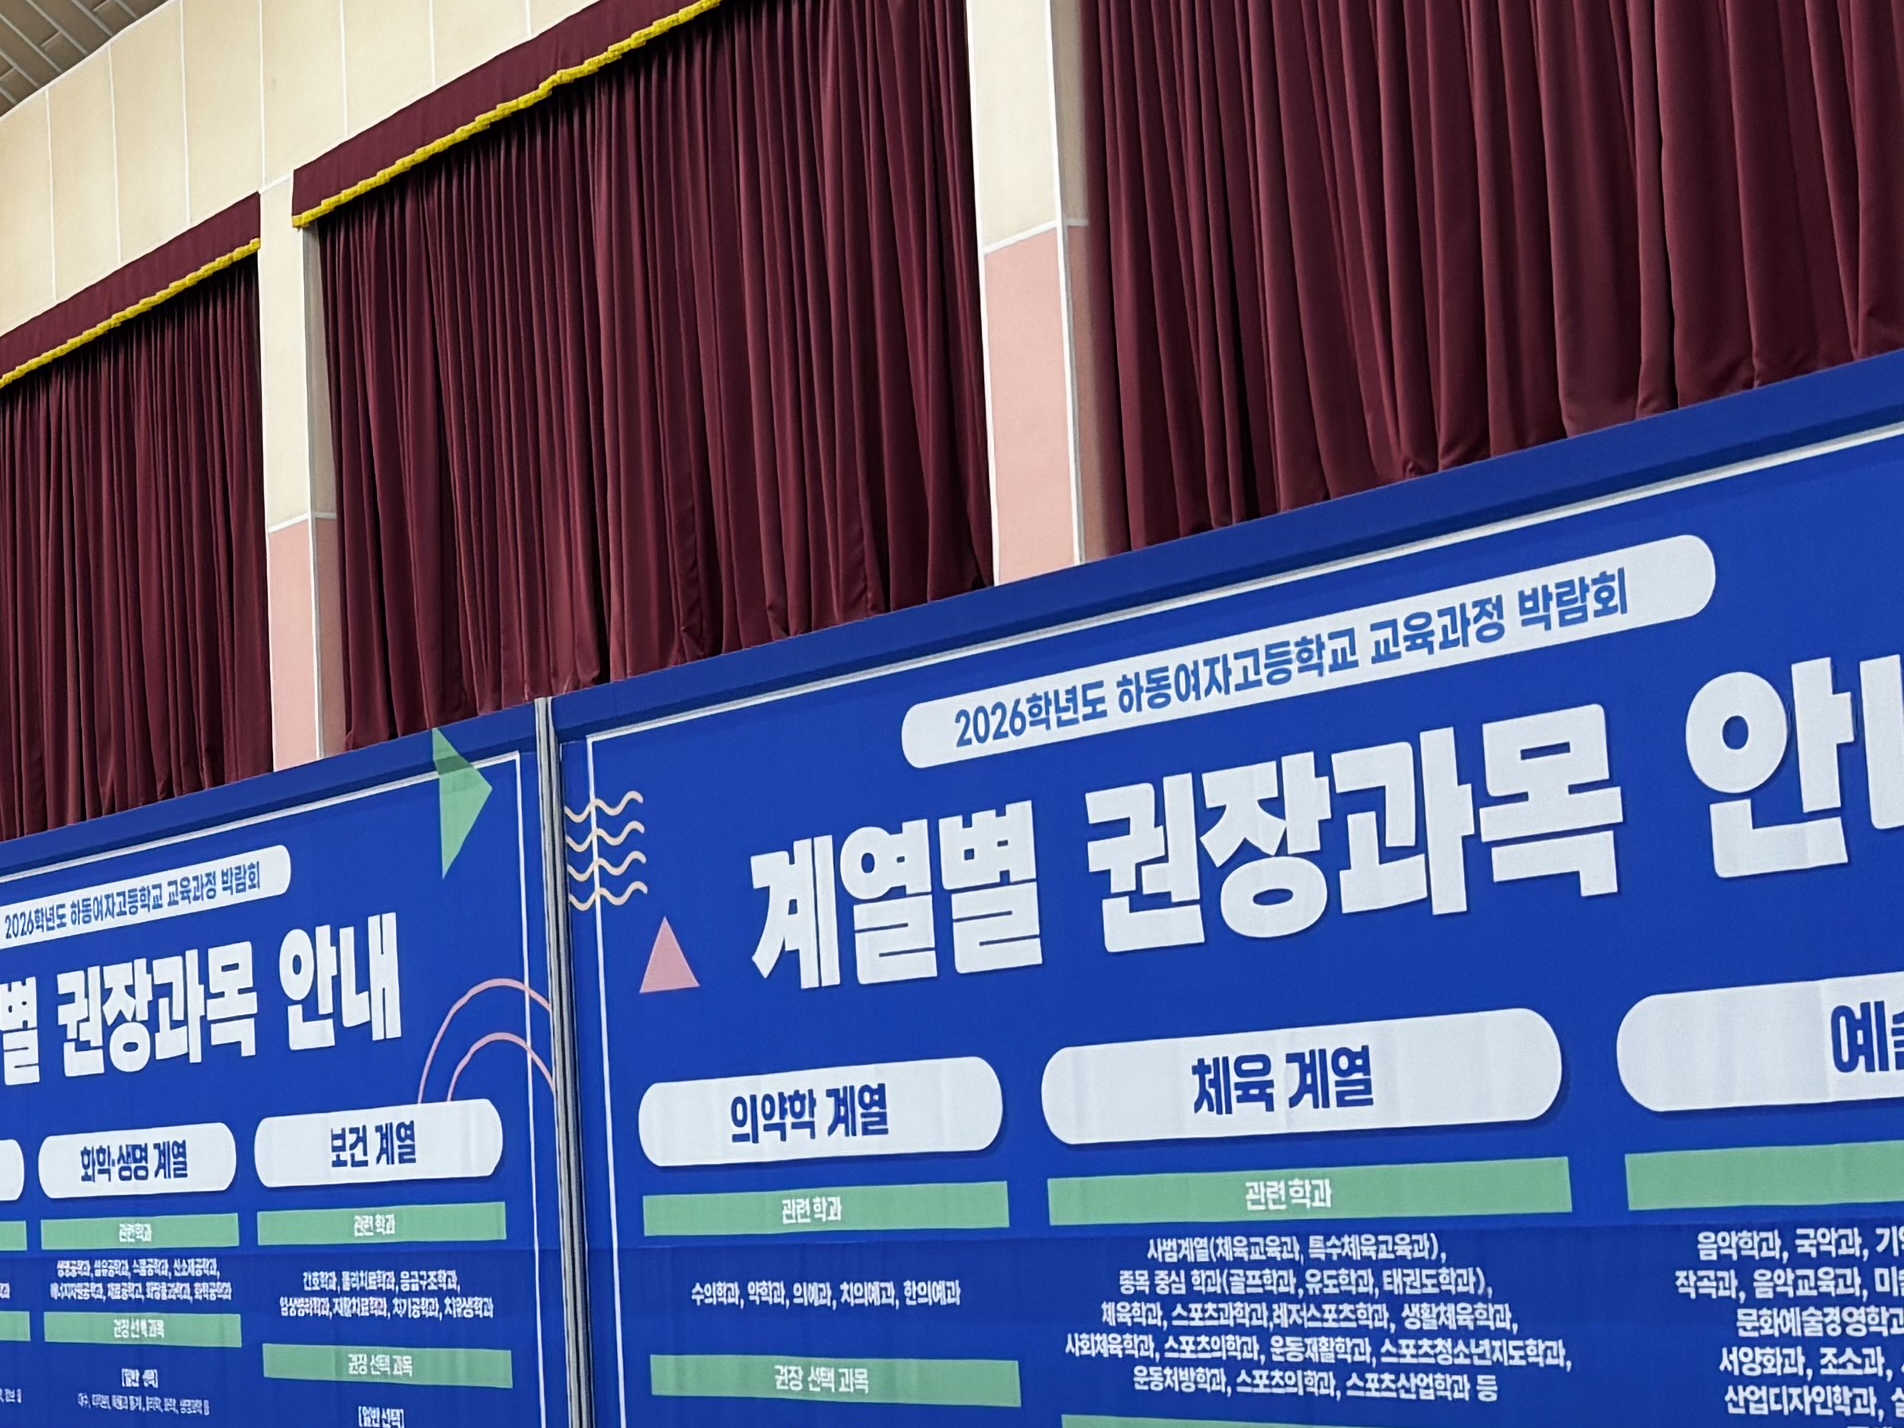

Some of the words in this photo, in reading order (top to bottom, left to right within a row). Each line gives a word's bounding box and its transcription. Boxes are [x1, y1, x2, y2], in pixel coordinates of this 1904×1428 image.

[954, 680, 1107, 748] 2026학년도
[1116, 628, 1359, 714] 하동여자고등학교
[1370, 595, 1505, 668] 교육과정
[1518, 568, 1628, 632] 박람회
[750, 799, 1042, 990] 계열별
[1085, 703, 1624, 953] 권장과목
[4, 900, 67, 940] 2026학년도
[70, 883, 163, 926] 하동여자고등학교
[167, 870, 217, 910] 교육과정
[221, 861, 262, 901] 박람회
[56, 940, 258, 1078] 권장과목
[278, 911, 402, 1052] 안내
[1192, 1053, 1275, 1115] 체육
[1285, 1045, 1374, 1109] 계열
[730, 1089, 816, 1144] 의약학
[827, 1083, 889, 1137] 계열
[153, 1139, 188, 1179] 계열
[330, 1126, 369, 1168] 보건
[373, 1119, 417, 1166] 계열
[781, 1199, 811, 1224] 관련
[813, 1197, 842, 1222] 학과
[1245, 1182, 1286, 1212] 관련
[1289, 1179, 1332, 1210] 학과
[1698, 1230, 1789, 1264] 음악학과,
[1795, 1228, 1869, 1262] 국악과,
[1119, 1270, 1149, 1295] 종목
[1154, 1270, 1186, 1295] 중심
[1676, 1270, 1746, 1303] 작곡과,
[1753, 1267, 1868, 1301] 음악교육과,
[1101, 1301, 1168, 1331] 체육학과,
[1402, 1303, 1519, 1335] 생활체육학과,
[1065, 1333, 1160, 1362] 사회체육학과,
[1164, 1335, 1266, 1365] 스포츠의학과,
[1380, 1338, 1572, 1372] 스포츠청소년지도학과,
[1719, 1346, 1813, 1381] 서양화과,
[1819, 1346, 1893, 1381] 조소과,
[1133, 1365, 1232, 1397] 운동처방학과,
[1236, 1369, 1341, 1401] 스포츠의학과,
[1346, 1373, 1470, 1400] 스포츠산업학과
[1476, 1375, 1498, 1402] 등
[1725, 1384, 1884, 1422] 산업디자인학과,
